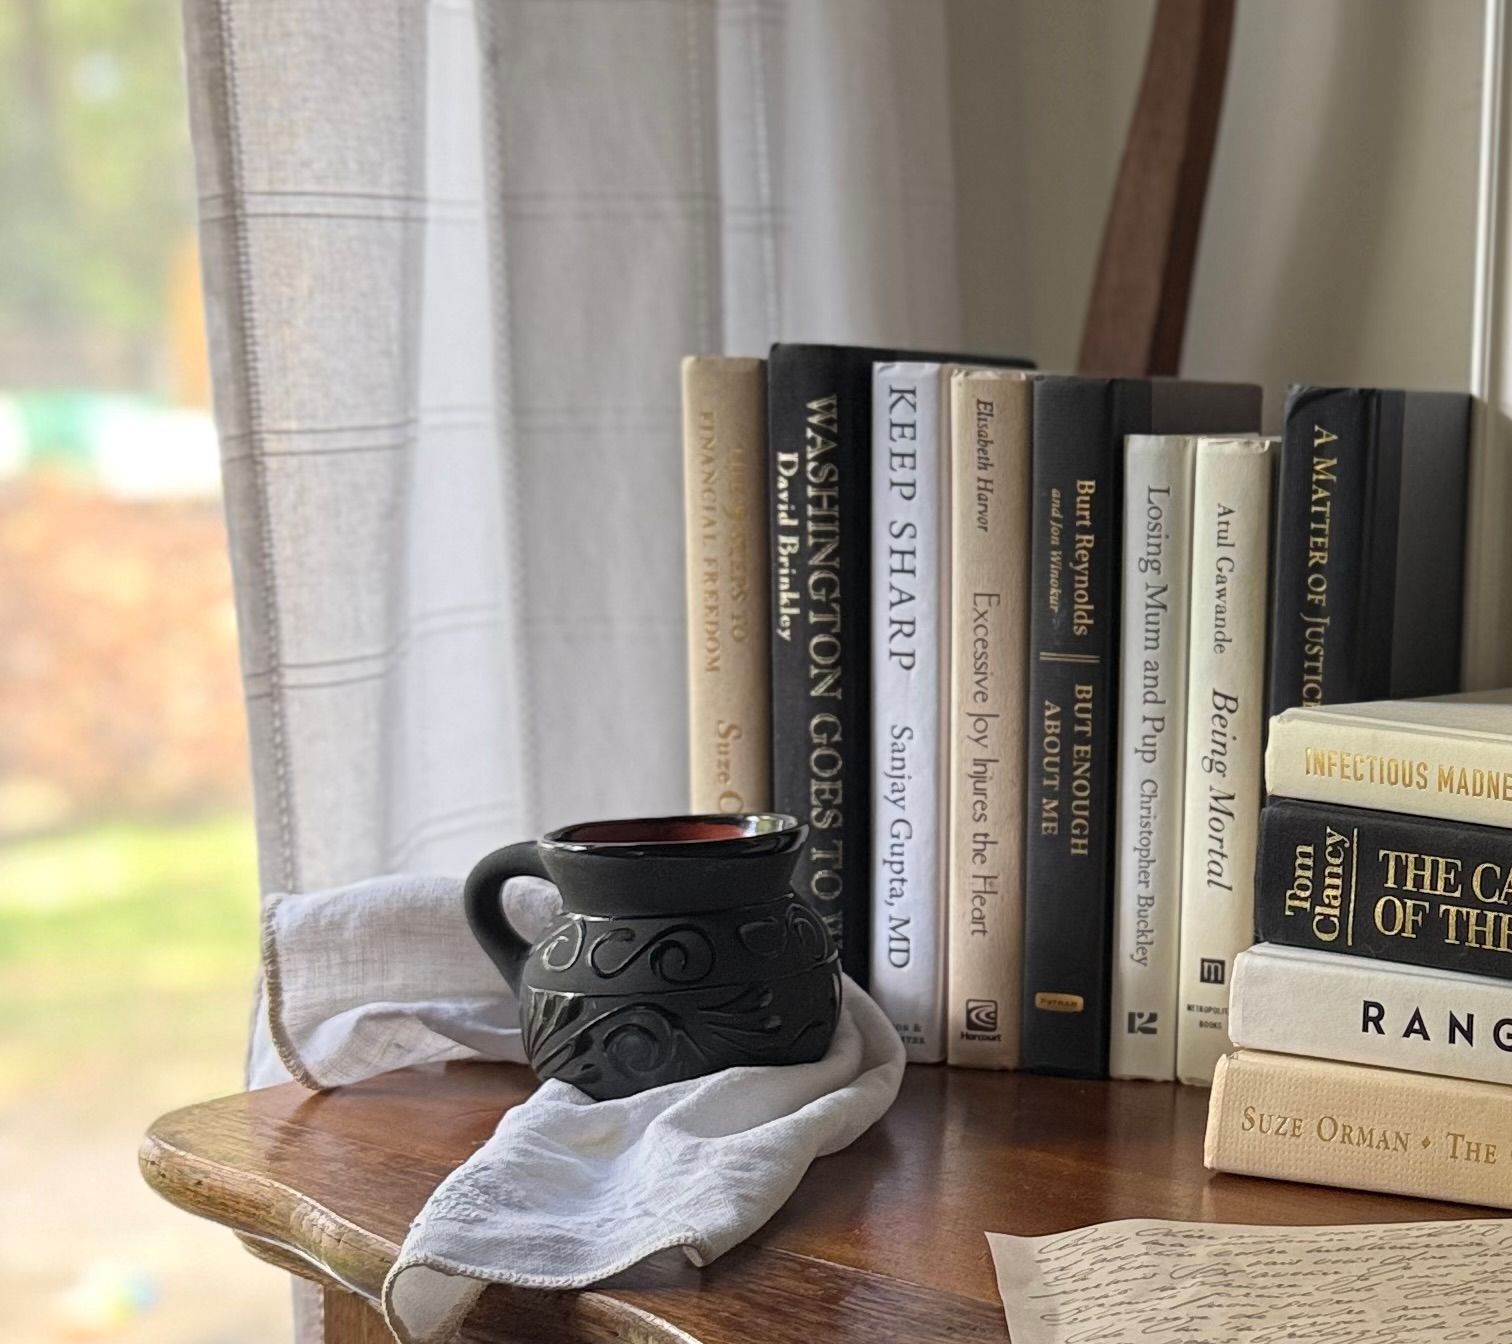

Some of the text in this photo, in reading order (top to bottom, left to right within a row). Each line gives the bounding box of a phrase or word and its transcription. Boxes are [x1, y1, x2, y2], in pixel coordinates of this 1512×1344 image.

[975, 398, 995, 533] Elisabeth Harvor
[1314, 424, 1338, 448] A
[701, 411, 721, 673] FINANCIAL FREEDOM
[776, 452, 801, 642] David Brinkley
[806, 394, 842, 700] WASHINGTON
[889, 385, 917, 672] KEEP SHARP
[1049, 488, 1063, 613] and Jon Winokur
[1069, 479, 1096, 636] Burt Reynolds
[1306, 456, 1338, 567] MATTER
[730, 610, 748, 643] TO
[1136, 485, 1170, 764] Losing Mum and Pup
[1213, 502, 1236, 654] Atul Gawande
[1306, 573, 1328, 605] OF
[809, 713, 843, 830] GOES
[966, 592, 1000, 937] Excessive Joy Injures the Heart
[1041, 700, 1061, 836] ABOUT ME
[1070, 685, 1094, 856] BUT ENOUGH
[1201, 688, 1240, 892] Being Mortal
[1305, 747, 1428, 790] INFECTIOUS
[810, 840, 843, 901] TO
[883, 724, 914, 970] Sanjay Gupta, MD
[1130, 779, 1158, 968] Christopher Buckley
[1285, 843, 1314, 916] Tom
[1312, 826, 1351, 942] Clancy
[1378, 849, 1462, 898] THE
[1374, 895, 1429, 939] OF
[961, 1031, 1002, 1042] Harcourt
[1241, 1105, 1303, 1139] SUZE
[1316, 1115, 1409, 1154] ORMAN
[1446, 1131, 1497, 1165] THE
